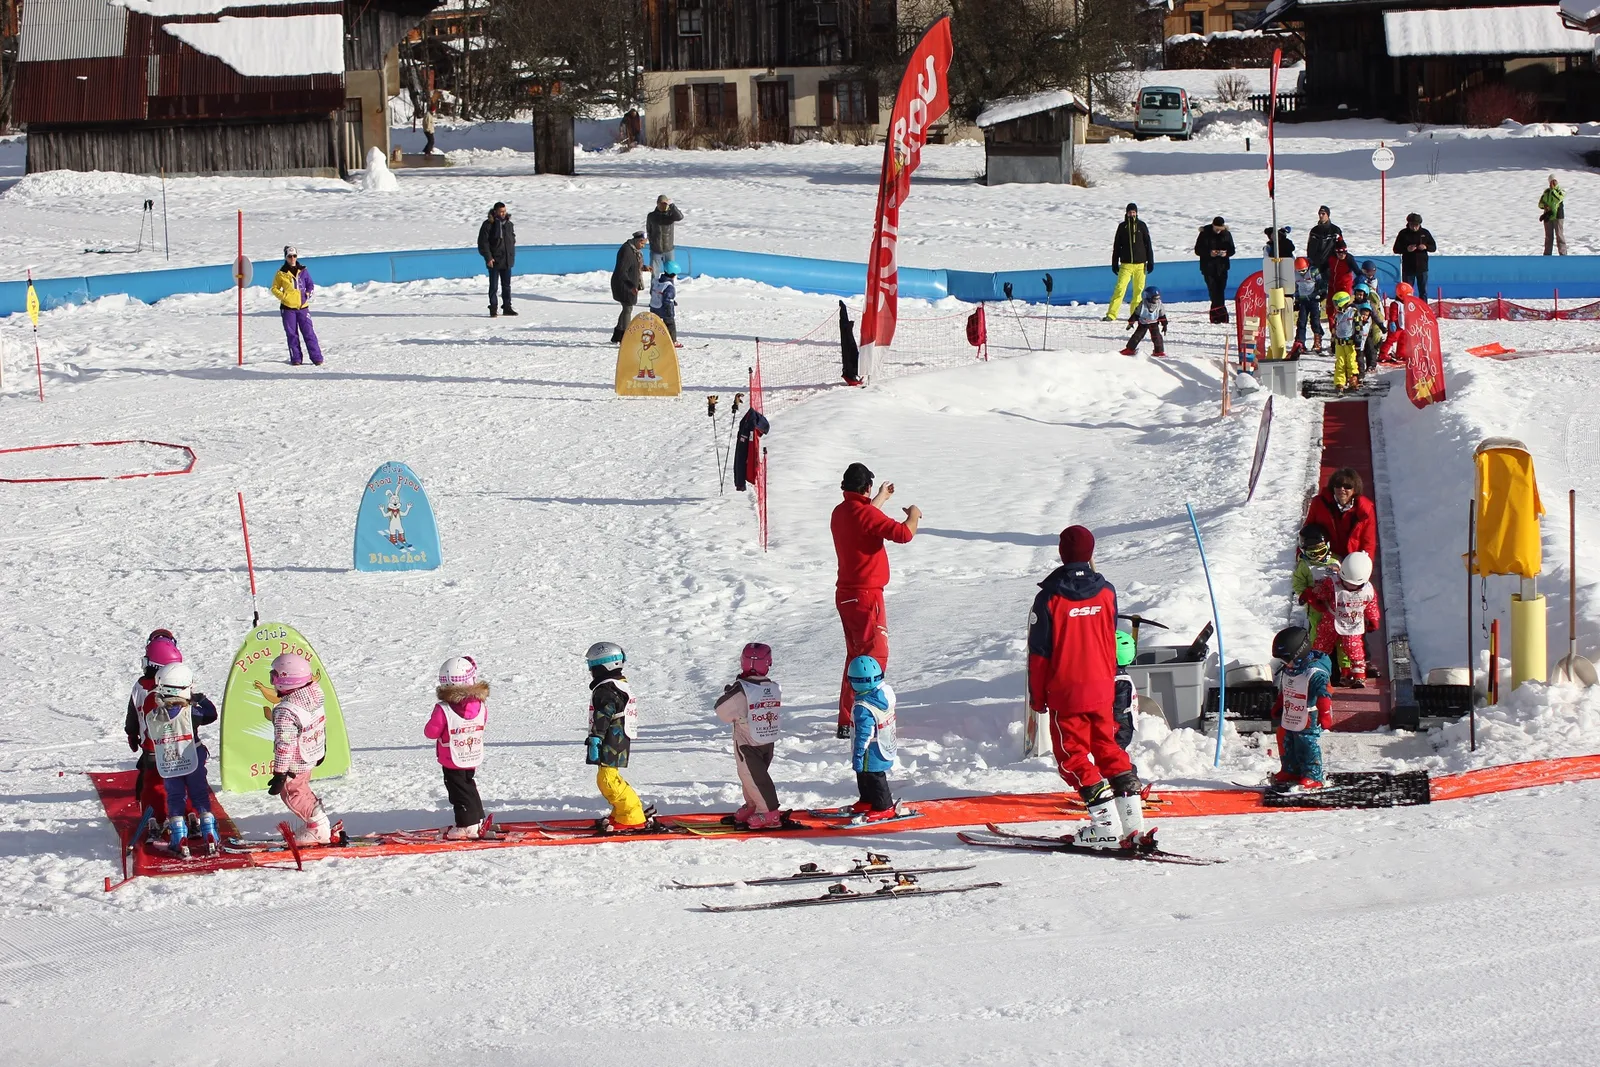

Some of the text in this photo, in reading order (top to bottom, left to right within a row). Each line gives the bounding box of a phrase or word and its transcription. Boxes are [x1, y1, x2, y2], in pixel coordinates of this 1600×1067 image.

[382, 463, 403, 473] Club
[368, 475, 420, 493] Piou Piou
[369, 551, 428, 564] Blanchot
[256, 627, 287, 641] Club
[236, 642, 313, 672] Piou Piou
